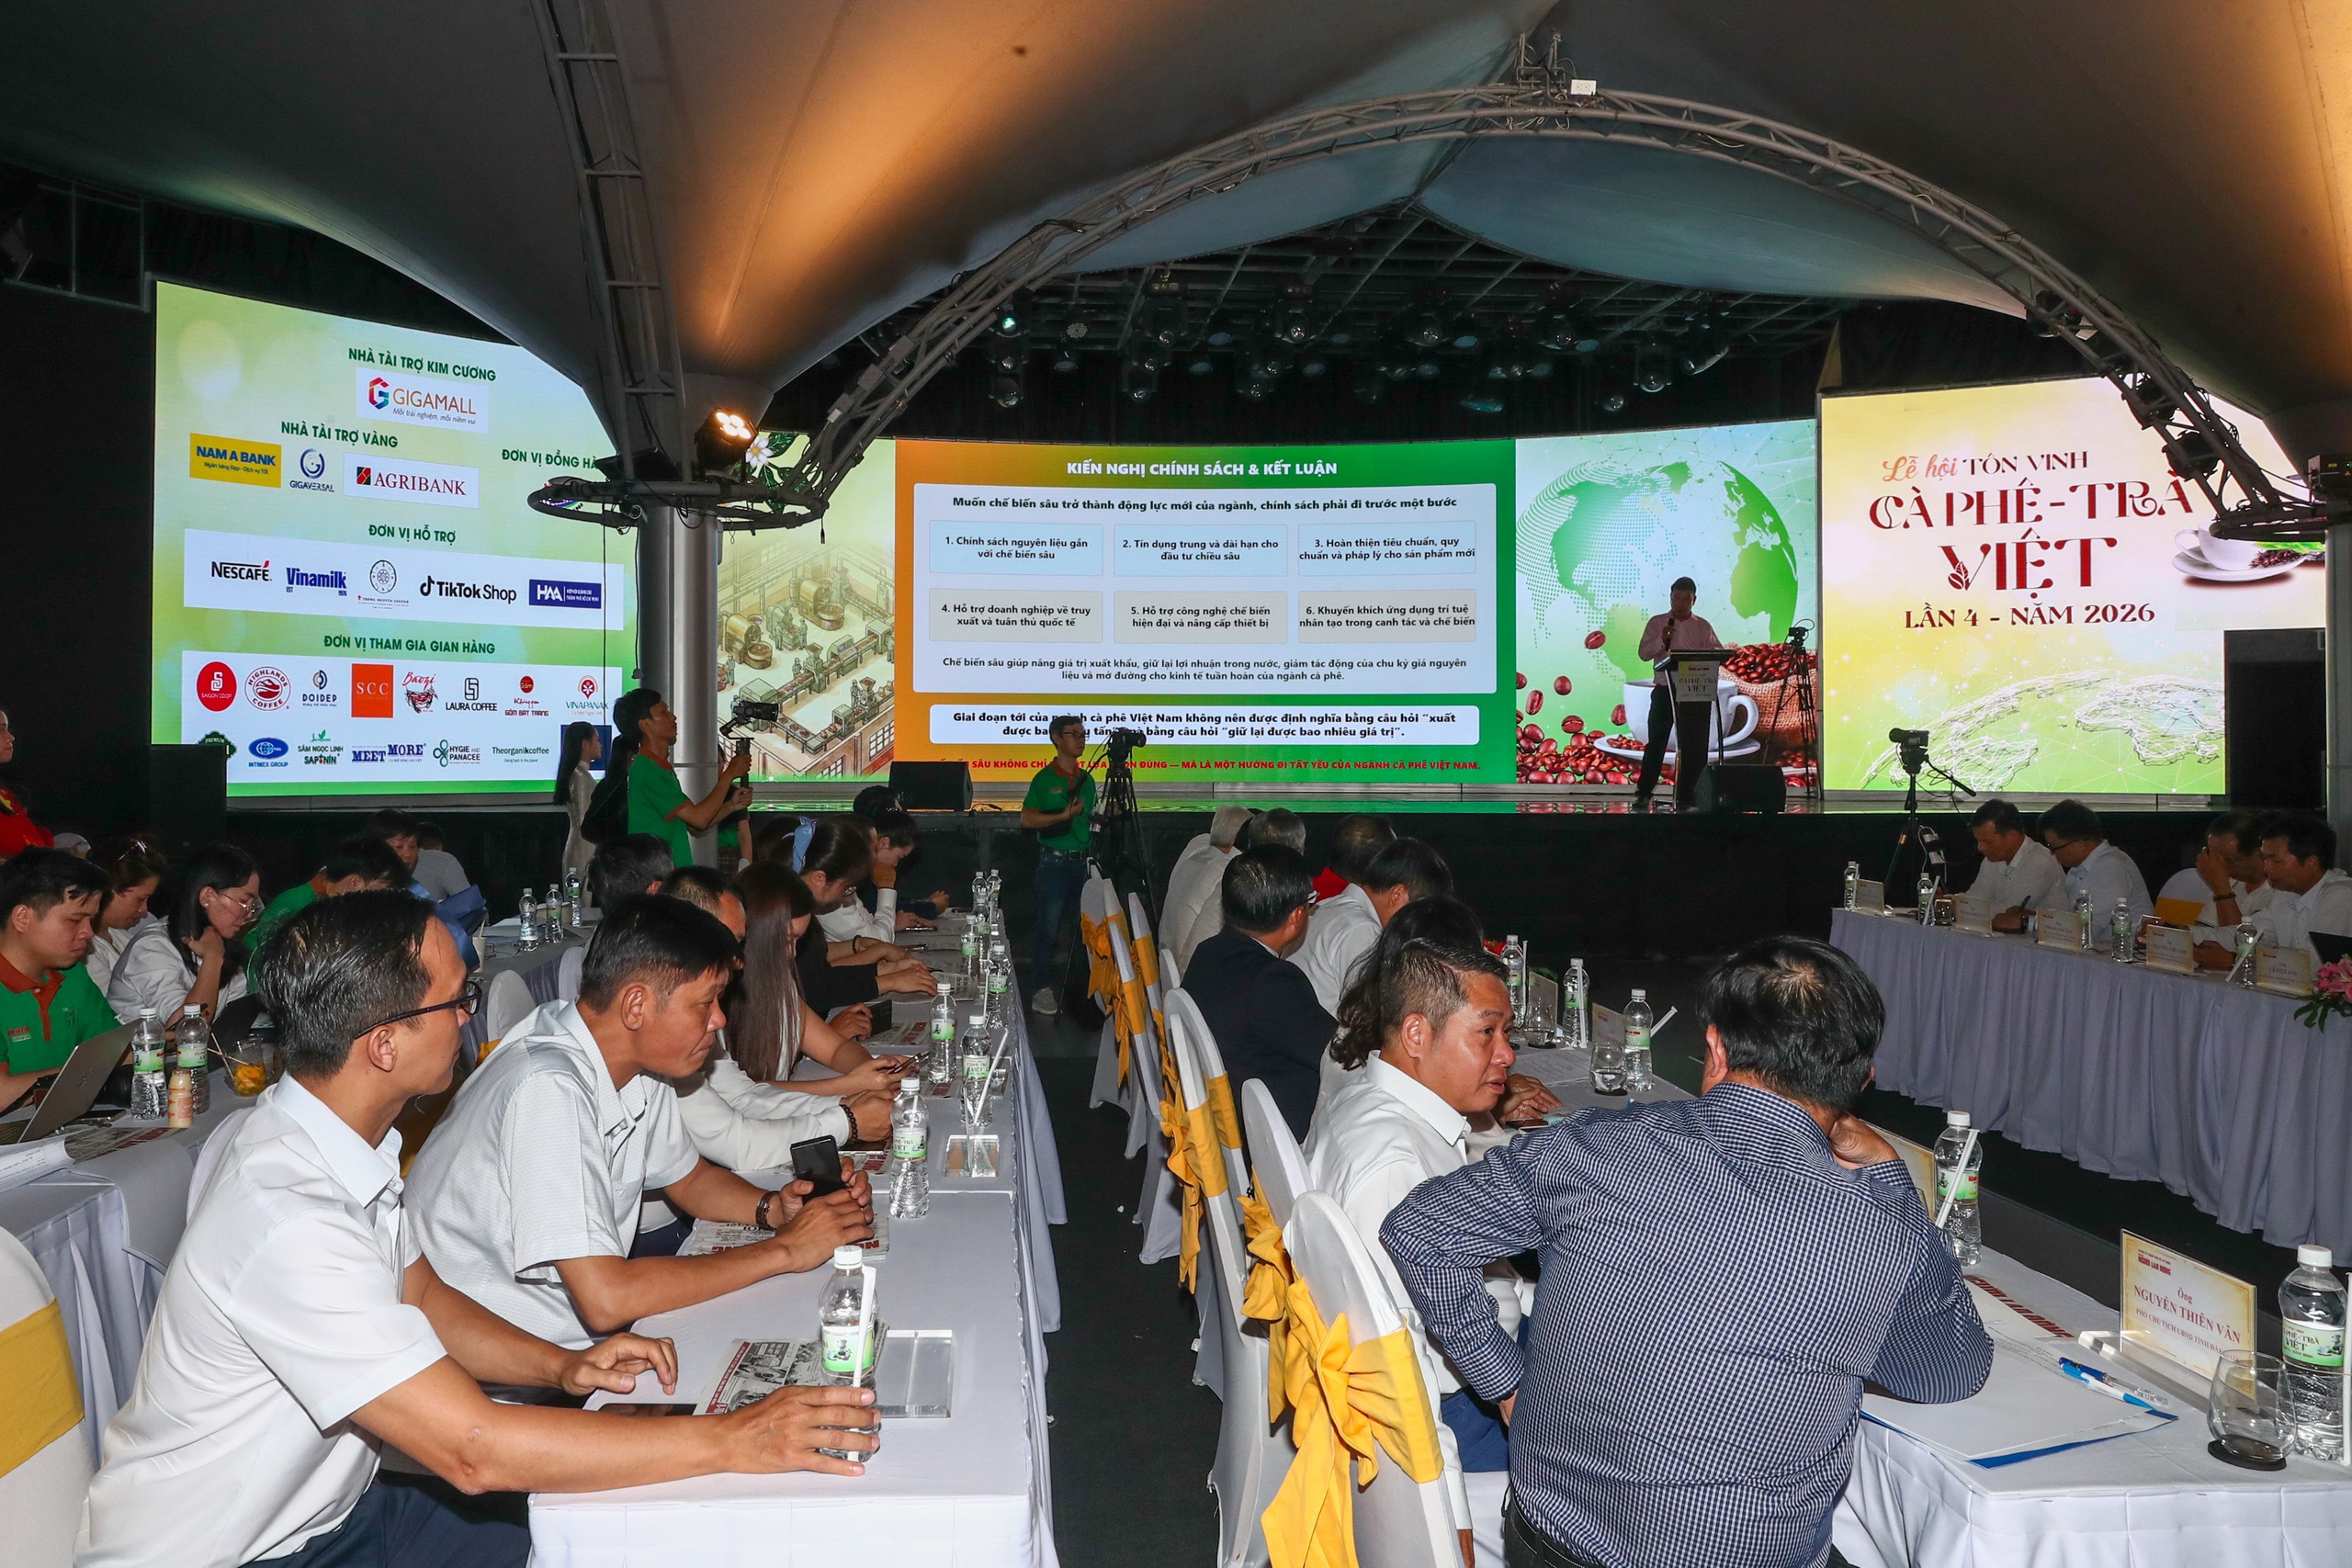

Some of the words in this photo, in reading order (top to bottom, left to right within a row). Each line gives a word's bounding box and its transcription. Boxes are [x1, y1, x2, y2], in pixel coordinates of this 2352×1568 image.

[349, 347, 375, 363] NHÀ
[379, 351, 397, 367] TÀI
[401, 356, 424, 374] TRỢ
[427, 361, 448, 375] KIM
[452, 365, 496, 381] CƯƠNG
[392, 389, 477, 414] GIGAMALL
[281, 421, 309, 436] NHÀ
[312, 423, 332, 439] TÀI
[335, 429, 358, 446] TRỢ
[362, 430, 398, 448] VÀNG
[197, 446, 227, 460] NAM
[229, 450, 239, 461] A
[241, 451, 277, 467] BANK
[502, 449, 526, 463] ĐƠN
[531, 452, 542, 467] VỊ
[546, 450, 580, 468] ĐỒNG
[1883, 454, 1917, 482] Lễ
[1926, 454, 1958, 481] hội
[1962, 452, 2018, 476] TÔN
[2027, 450, 2087, 471] VINH
[1067, 457, 1102, 475] KIẾN
[1106, 462, 1146, 479] NGHỊ
[1148, 459, 1200, 476] CHÍNH
[1203, 460, 1244, 476] SÁCH
[1248, 463, 1260, 476] &
[1263, 458, 1292, 476] KẾT
[1295, 459, 1338, 478] LUẬN
[289, 479, 334, 493] GIGAVERSAL
[374, 472, 467, 496] AGRIBANK
[953, 496, 986, 507] Muốn
[989, 497, 1010, 508] chế
[1012, 498, 1036, 508] biến
[1039, 499, 1059, 509] sâu
[1061, 499, 1080, 509] trở
[1081, 500, 1115, 510] thành
[1117, 500, 1148, 513] động
[1149, 500, 1168, 513] lực
[1170, 501, 1193, 511] mới
[1195, 500, 1216, 511] của
[1217, 500, 1257, 513] ngành,
[1260, 500, 1292, 510] chính
[1295, 500, 1320, 510] sách
[1322, 499, 1348, 512] phải
[1350, 499, 1363, 509] đi
[1364, 498, 1397, 509] trước
[1400, 498, 1424, 510] một
[1427, 496, 1457, 507] bước
[1870, 485, 1934, 531] CÀ
[368, 525, 395, 538] ĐƠN
[399, 527, 411, 542] VỊ
[413, 525, 432, 541] HỖ
[435, 530, 458, 546] TRỢ
[945, 536, 954, 545] 1.
[956, 536, 985, 546] Chính
[987, 536, 1009, 547] sách
[1011, 537, 1047, 549] nguyên
[1049, 538, 1068, 547] liệu
[1069, 537, 1088, 549] gắn
[1122, 539, 1132, 548] 2.
[1134, 539, 1149, 548] Tín
[1151, 539, 1177, 550] dụng
[1179, 540, 1206, 551] trung
[1208, 539, 1220, 548] và
[1222, 539, 1238, 548] dài
[1240, 539, 1259, 550] hạn
[1261, 539, 1279, 548] cho
[1315, 538, 1324, 548] 3.
[1326, 538, 1352, 547] Hoàn
[1354, 537, 1381, 549] thiện
[1383, 537, 1402, 547] tiêu
[1405, 536, 1438, 547] chuẩn,
[1440, 538, 1460, 550] quy
[978, 548, 993, 558] với
[995, 549, 1013, 558] chế
[1014, 549, 1036, 558] biến
[1038, 549, 1056, 559] sâu
[1160, 551, 1179, 560] đầu
[1182, 552, 1193, 560] tư
[1194, 551, 1221, 560] chiều
[1223, 551, 1240, 560] sâu
[1299, 549, 1329, 560] chuẩn
[1330, 550, 1342, 559] và
[1345, 550, 1371, 562] pháp
[1373, 550, 1382, 561] lý
[1384, 549, 1402, 559] cho
[1404, 549, 1421, 558] sản
[1424, 547, 1453, 560] phẩm
[1455, 547, 1476, 558] mới
[1938, 526, 2117, 599] VIỆT
[286, 567, 347, 590] Vinamilk
[436, 581, 482, 600] TikTok
[483, 585, 516, 604] Shop
[537, 584, 563, 603] HAA
[1905, 602, 1956, 628] LẦN
[1963, 610, 1978, 626] 4
[2011, 602, 2074, 626] NĂM
[2084, 603, 2155, 625] 2026
[323, 635, 351, 649] ĐƠN
[355, 637, 366, 652] VỊ
[369, 637, 402, 650] THAM
[405, 639, 426, 651] GIA
[430, 640, 459, 653] GIAN
[463, 639, 496, 655] HÀNG
[247, 669, 288, 687] HIGHLANDS
[252, 698, 284, 710] COFFEE
[302, 694, 337, 703] DOIDEP
[446, 701, 470, 713] LAURA
[472, 702, 497, 713] COFFEE
[352, 750, 386, 762] MEET
[388, 744, 424, 756] MORE
[2177, 1287, 2193, 1305] Ông
[2179, 1305, 2214, 1332] THIÊN
[2216, 1322, 2241, 1345] VĂN
